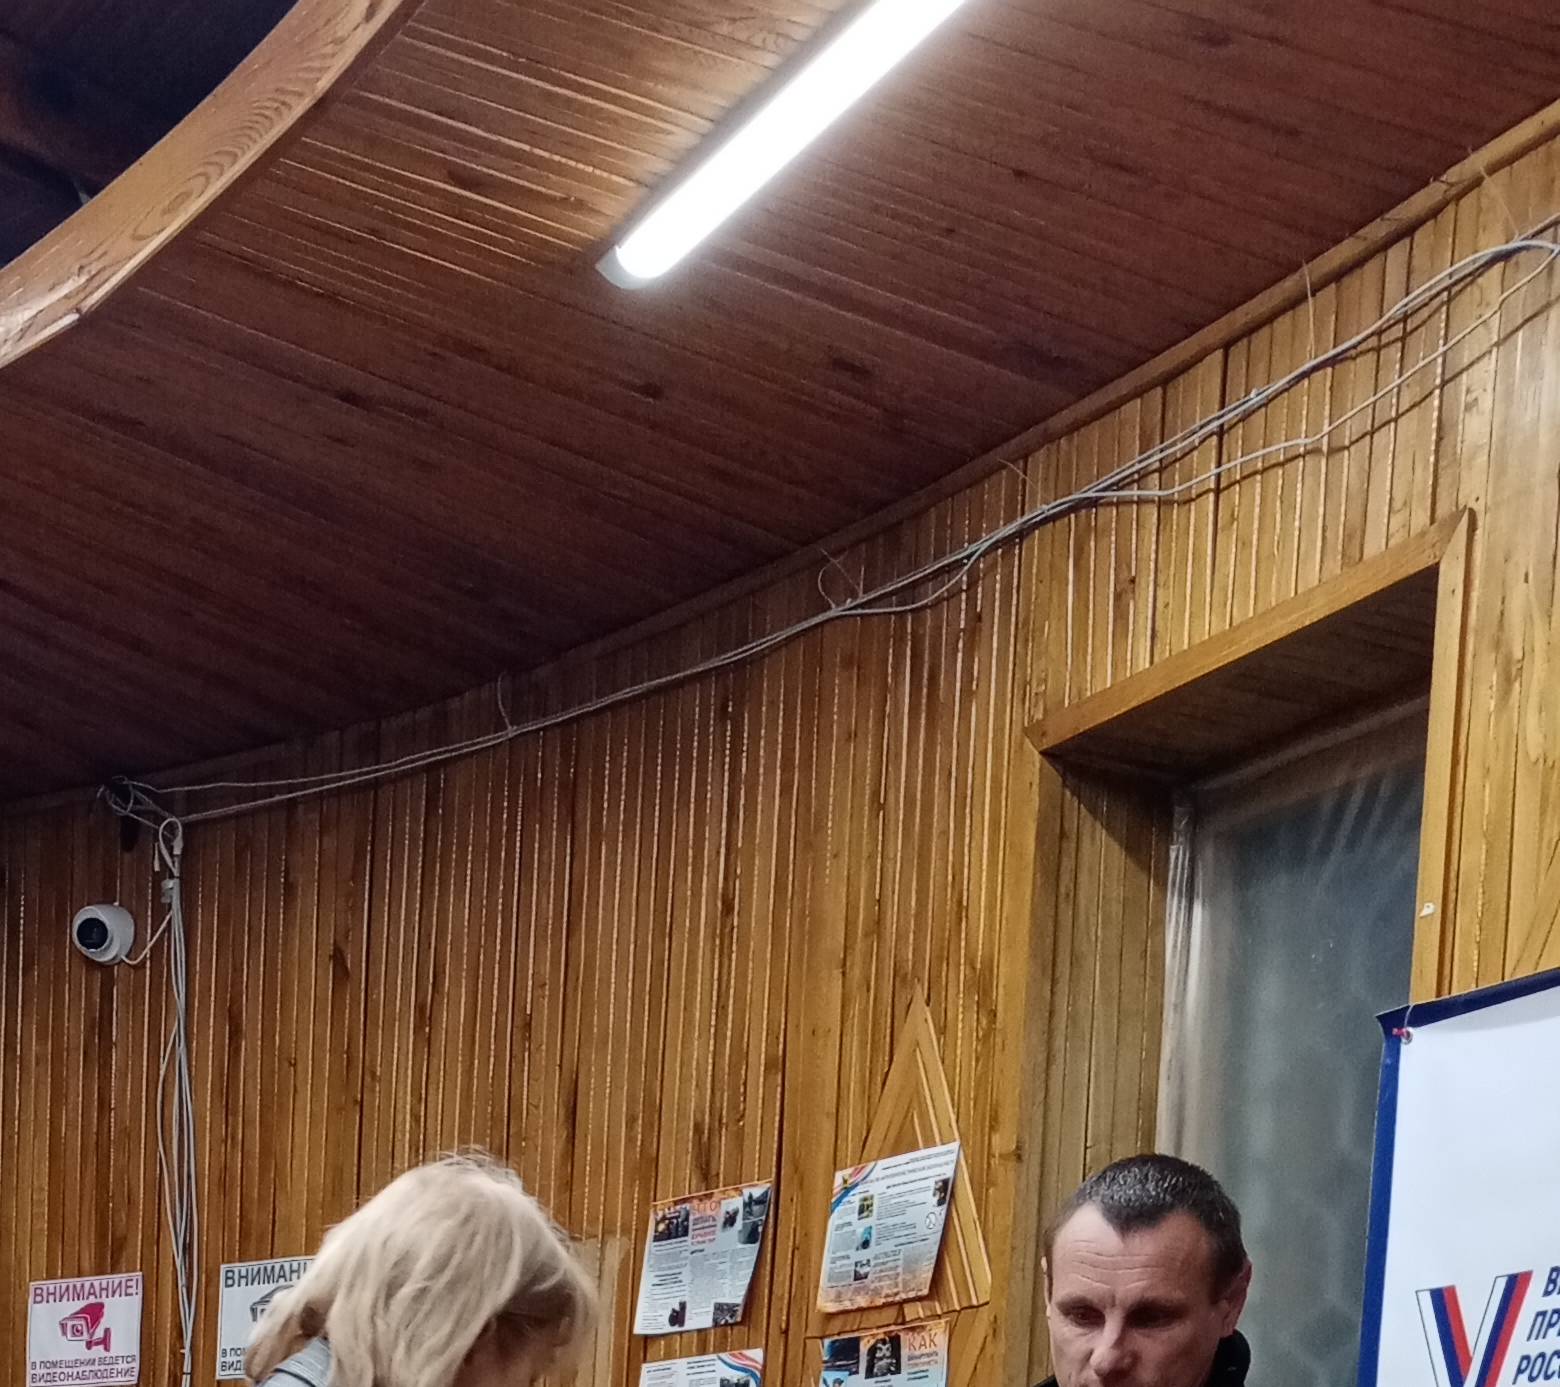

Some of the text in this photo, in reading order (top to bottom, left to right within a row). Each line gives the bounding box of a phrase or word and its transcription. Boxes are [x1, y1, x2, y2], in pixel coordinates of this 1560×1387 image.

[224, 1262, 308, 1288] ВНИМАН
[32, 1278, 139, 1304] ВНИМАНИЕ!
[909, 1332, 938, 1351] КАК
[31, 1355, 136, 1370] В ПОМЕЩЕНИИ ВЕДЕТСЯ
[31, 1367, 136, 1383] ВИДЕОНАБЛЮДЕНИЕ
